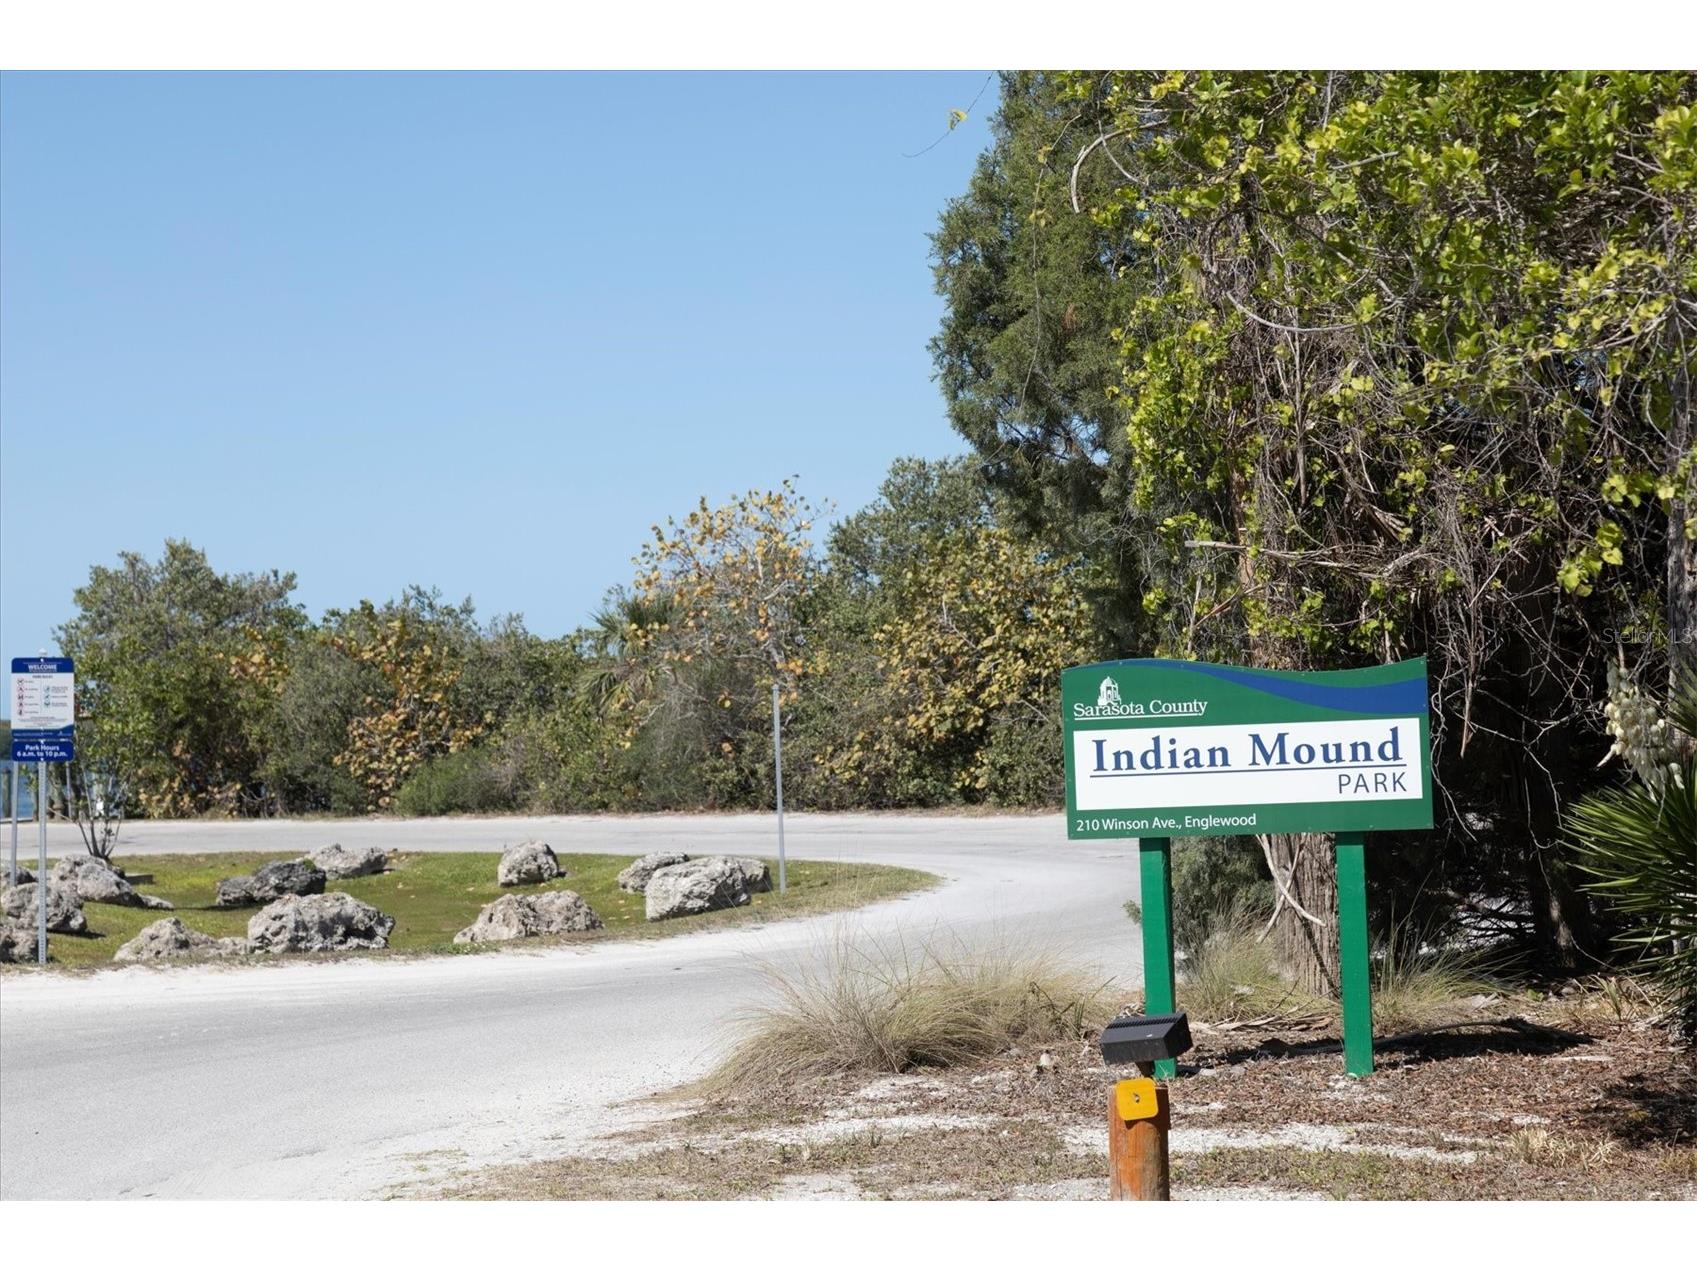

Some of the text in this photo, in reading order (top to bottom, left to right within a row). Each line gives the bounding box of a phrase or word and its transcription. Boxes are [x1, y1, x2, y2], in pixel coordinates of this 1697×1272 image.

[1073, 699, 1208, 717] Sarasota County
[1091, 726, 1404, 772] Indian Mound
[1337, 772, 1407, 794] PARK
[1076, 813, 1257, 832] 210 Winson Ave., Englewood
